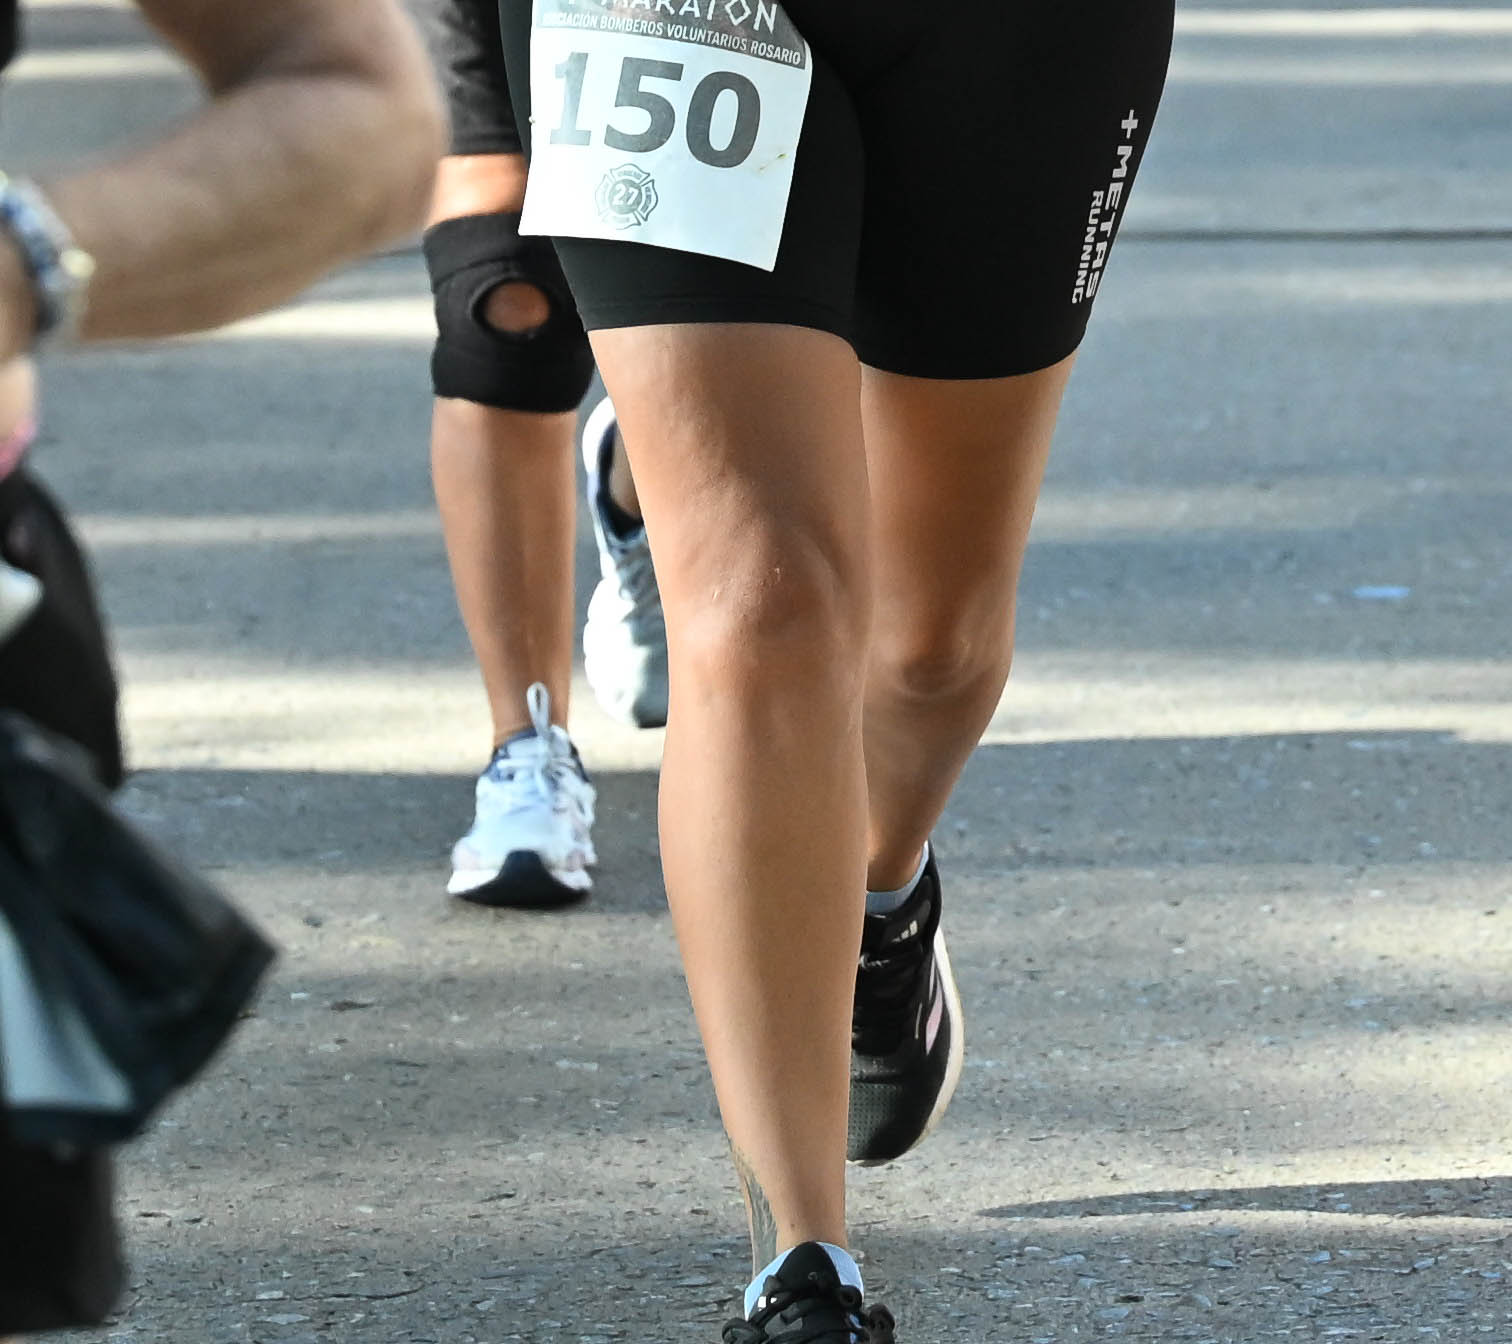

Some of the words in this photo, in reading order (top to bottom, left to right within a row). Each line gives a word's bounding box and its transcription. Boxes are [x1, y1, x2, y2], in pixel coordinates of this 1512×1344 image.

[599, 14, 664, 37] BOMBEROS
[665, 23, 748, 52] VOLUNTARIOS
[749, 40, 801, 67] ROSARIO
[550, 51, 762, 169] 150
[611, 183, 639, 206] 27
[1071, 190, 1105, 305] RUNNING
